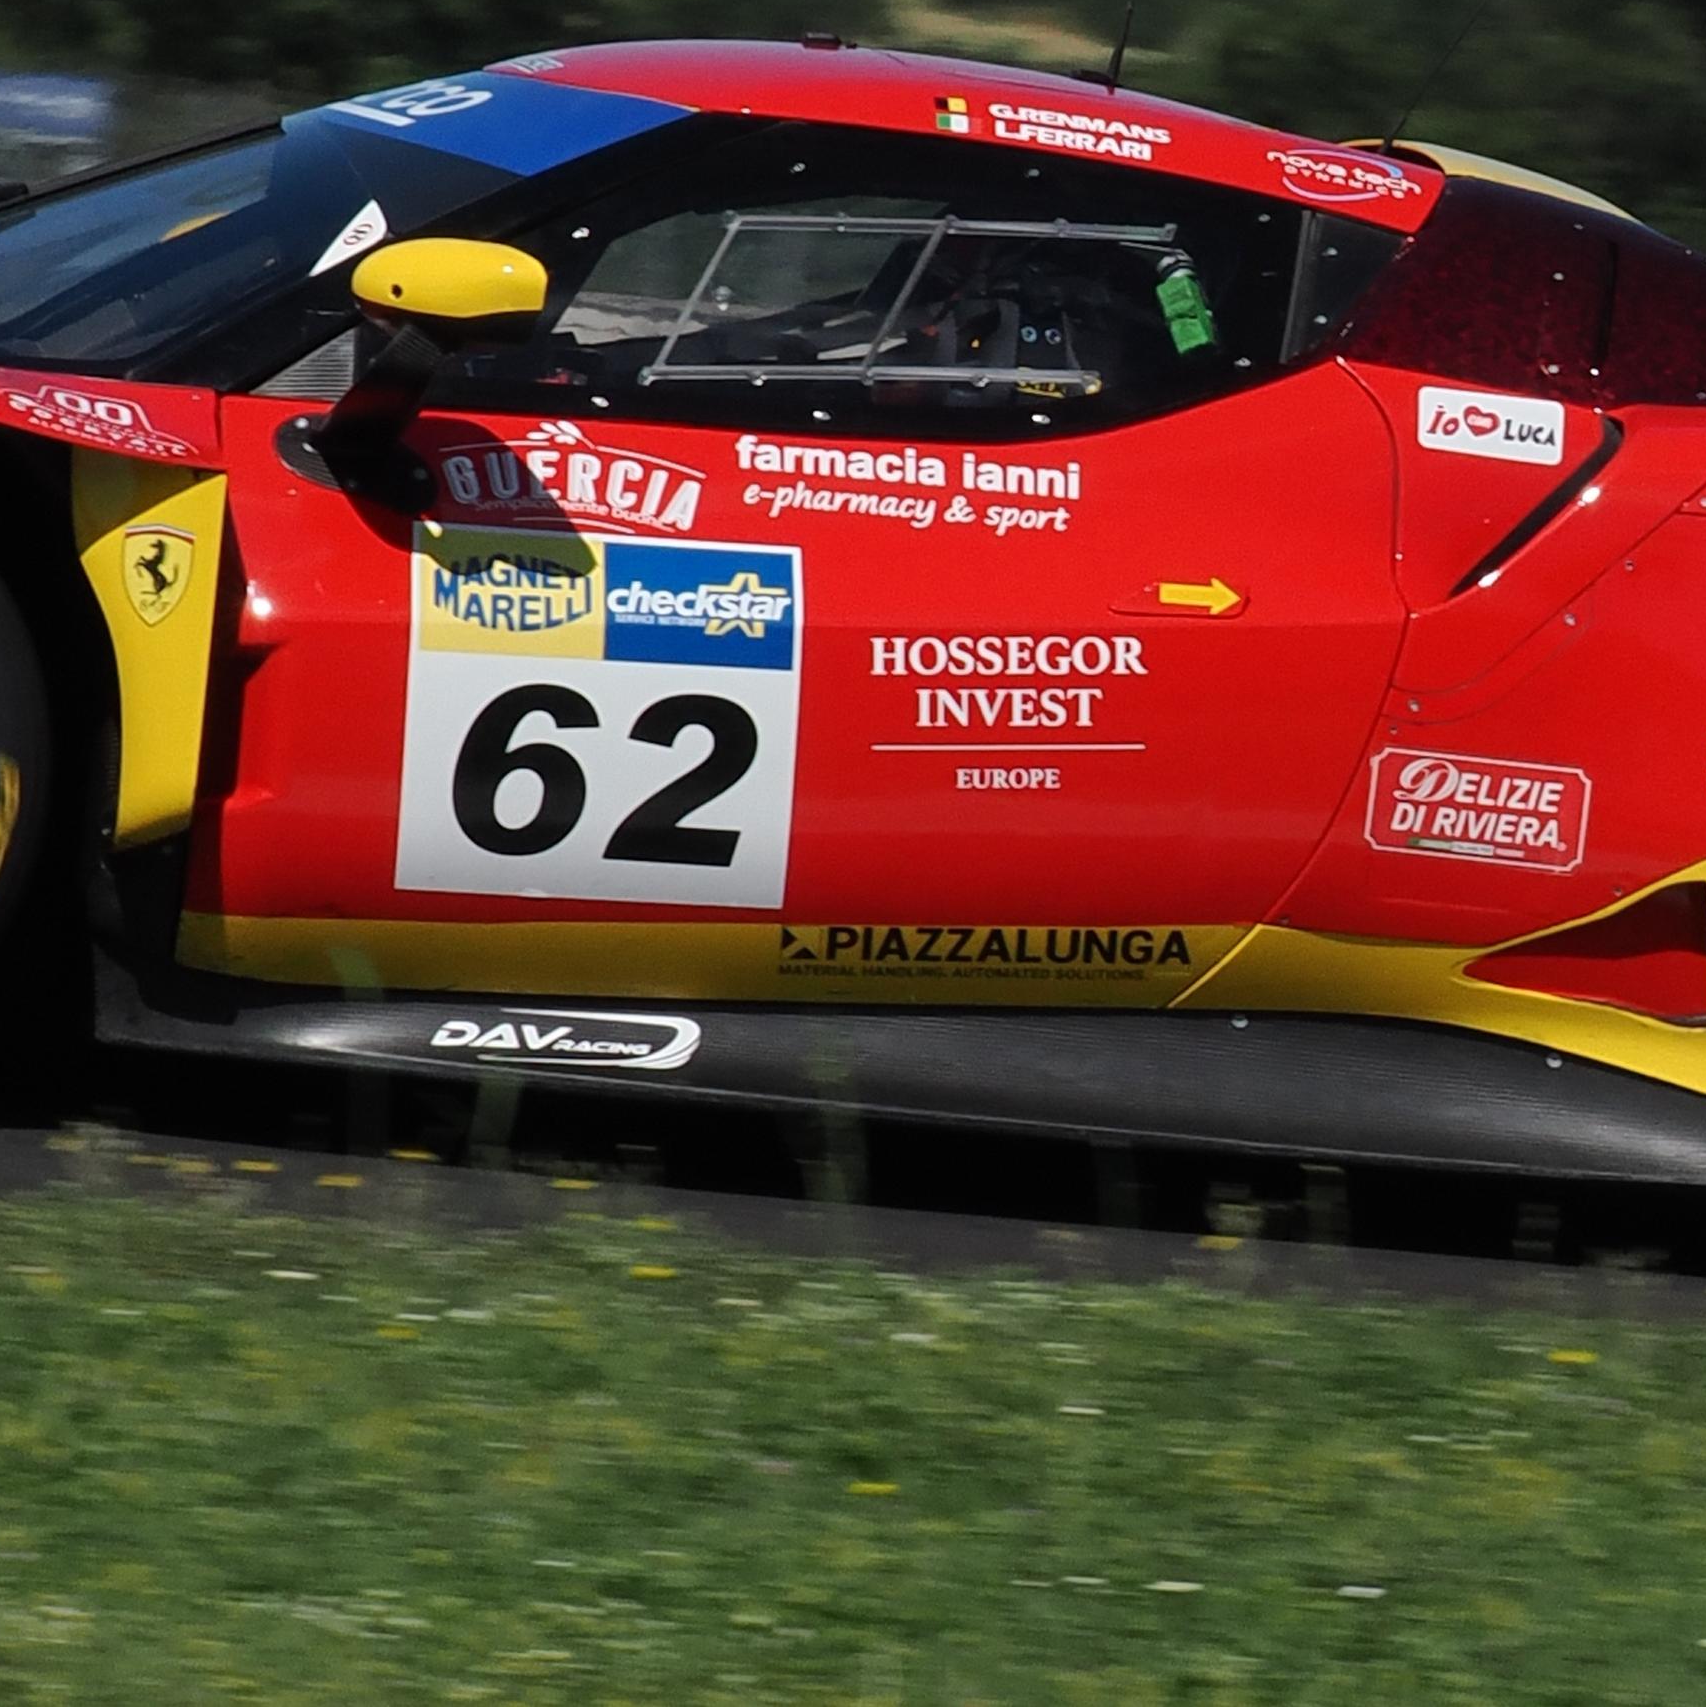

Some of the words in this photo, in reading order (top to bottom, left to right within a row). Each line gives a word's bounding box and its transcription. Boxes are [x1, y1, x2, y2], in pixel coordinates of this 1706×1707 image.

[988, 103, 1172, 144] G.RENMANS
[1503, 419, 1556, 446] LUCA
[735, 434, 946, 487] farmacia
[962, 453, 1081, 500] ianni
[443, 450, 703, 532] GUERCIA
[743, 481, 937, 529] e-pharmacy
[944, 496, 976, 523] &
[983, 505, 1071, 536] sport
[433, 588, 592, 632] MARELLI
[606, 580, 792, 621] checkstar
[870, 636, 1148, 676] HOSSEGOR
[915, 688, 1103, 727] INVEST
[452, 683, 759, 868] 62
[956, 768, 1061, 789] EUROPE
[1390, 802, 1427, 833] DI
[1431, 807, 1560, 848] RIVIERA
[826, 926, 1191, 965] PIAZZALUNGA
[431, 1020, 573, 1050] DAV
